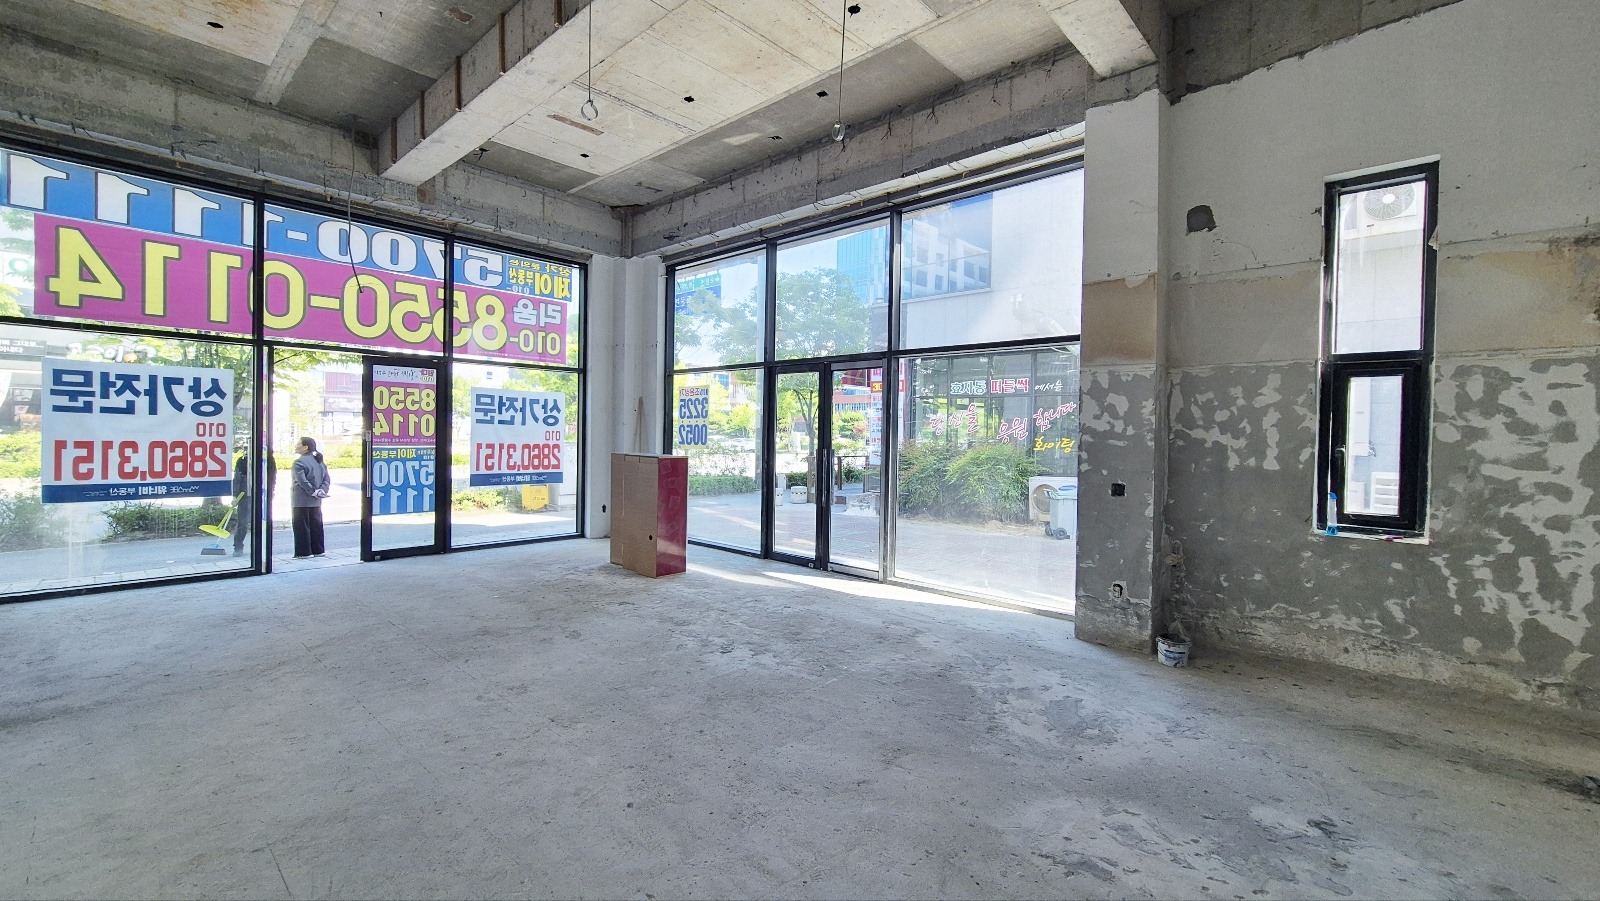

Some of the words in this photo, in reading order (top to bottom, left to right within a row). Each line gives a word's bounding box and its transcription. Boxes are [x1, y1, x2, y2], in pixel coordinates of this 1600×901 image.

[950, 380, 987, 395] 효자동
[990, 378, 1030, 393] 떠들썩
[997, 417, 1029, 444] 응원
[1033, 401, 1078, 433] 합니다
[1033, 436, 1076, 454] 화이팅
